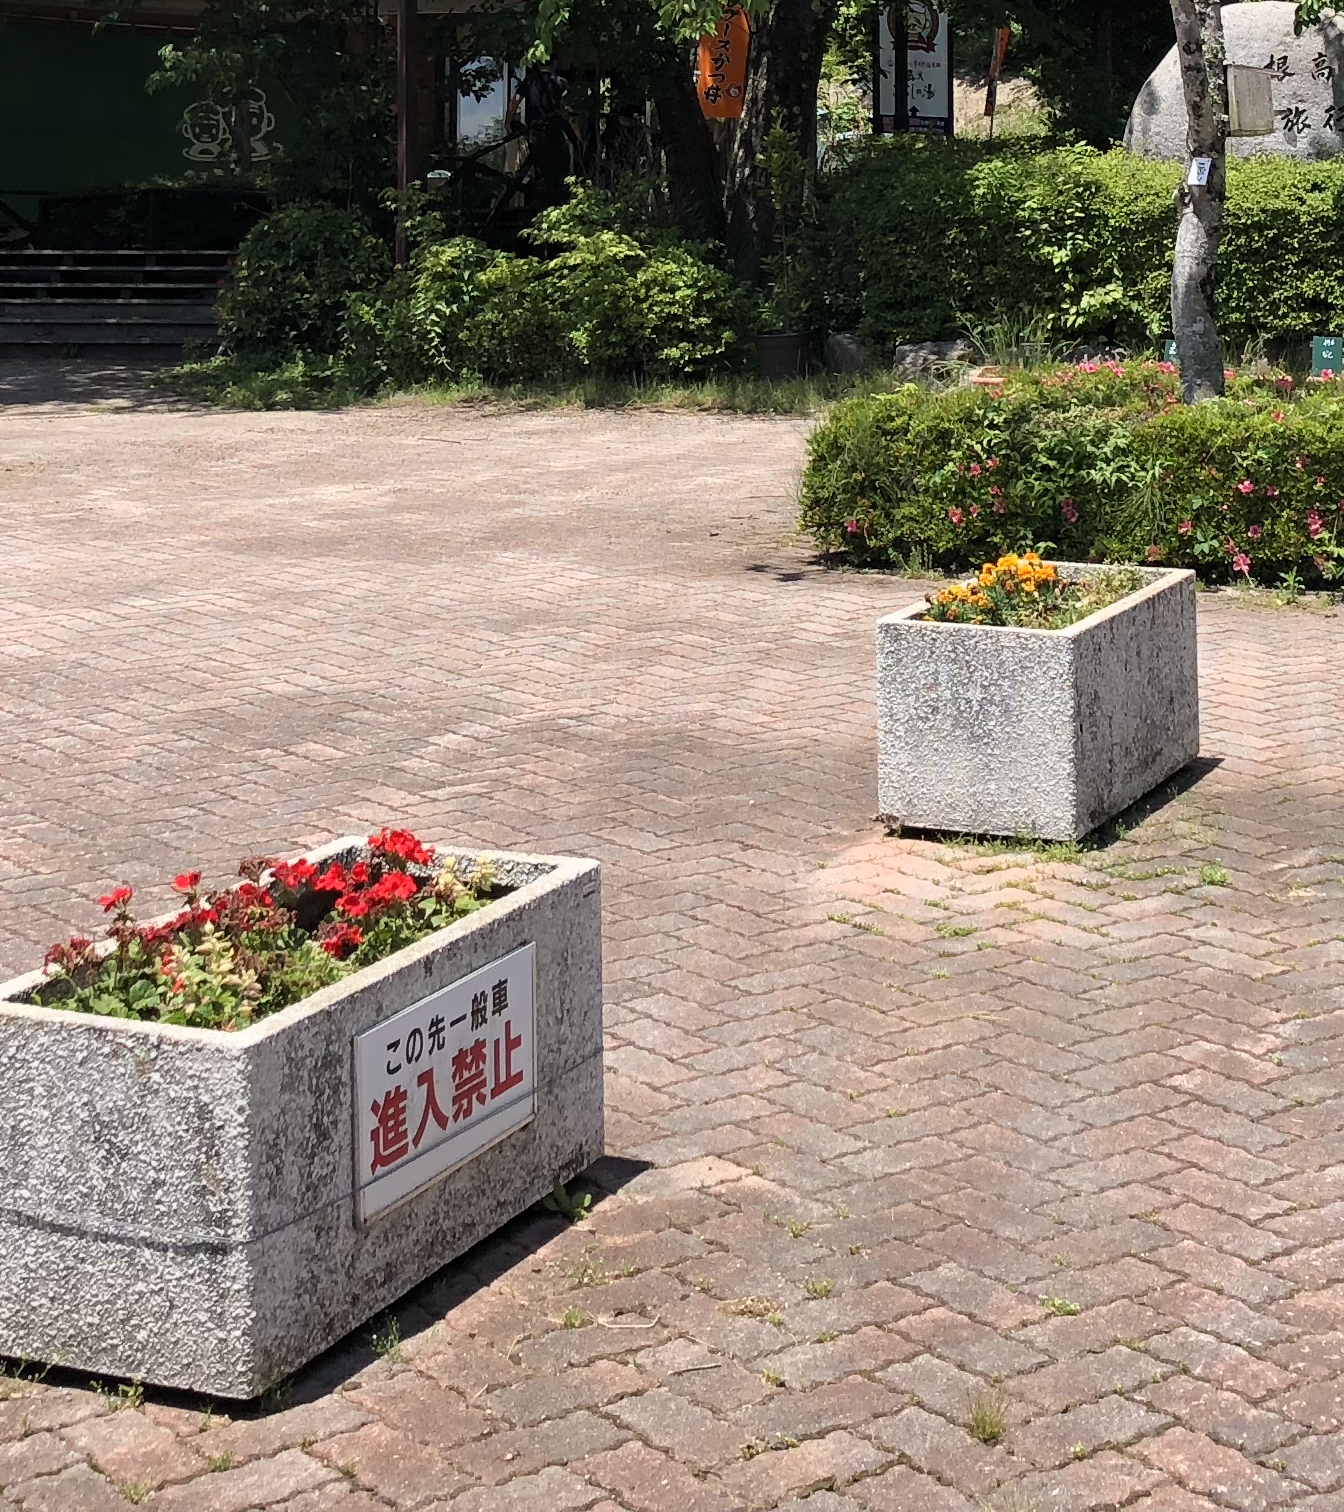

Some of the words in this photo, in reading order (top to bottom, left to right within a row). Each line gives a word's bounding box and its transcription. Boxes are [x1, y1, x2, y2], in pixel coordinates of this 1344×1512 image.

[386, 978, 509, 1076] この先一般車
[370, 1019, 524, 1176] 進入禁止
